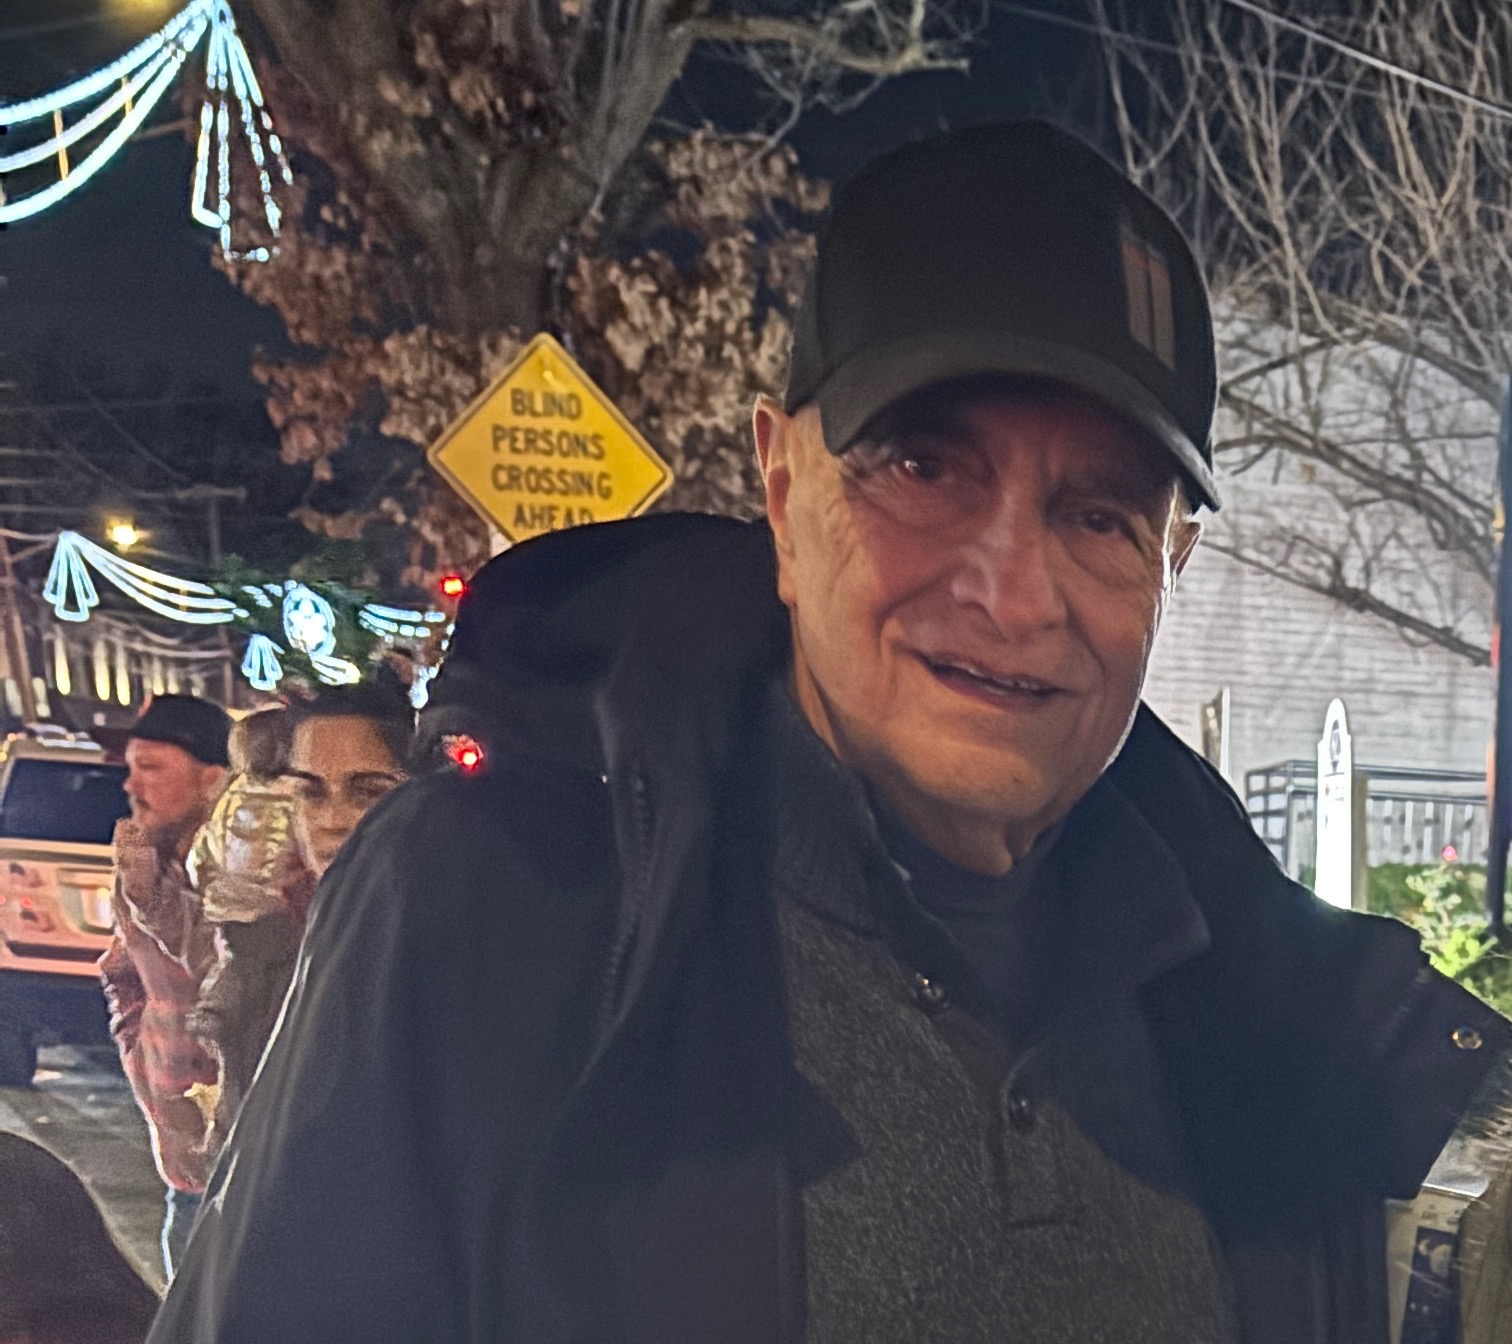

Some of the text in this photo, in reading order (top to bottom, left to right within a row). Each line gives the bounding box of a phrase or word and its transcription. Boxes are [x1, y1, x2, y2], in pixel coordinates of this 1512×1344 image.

[510, 388, 583, 420] BLIND
[492, 425, 606, 461] PERSONS
[491, 464, 613, 500] CROSSING
